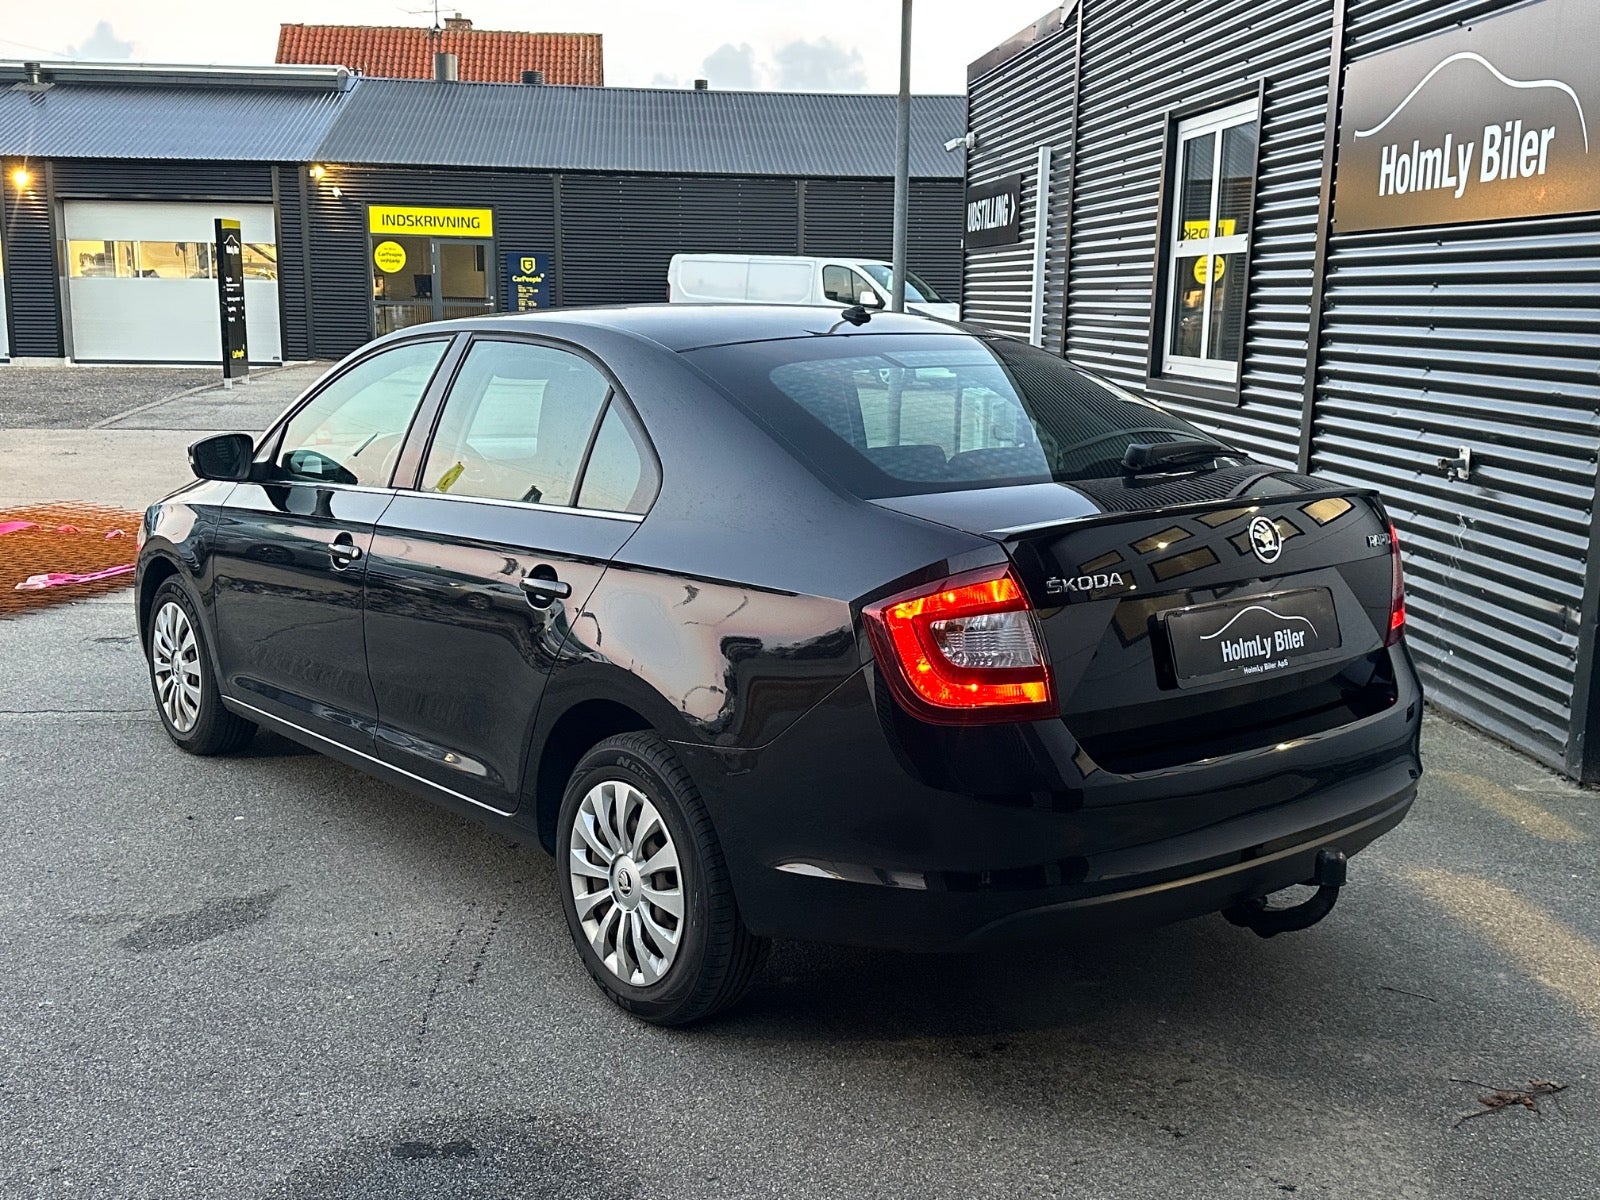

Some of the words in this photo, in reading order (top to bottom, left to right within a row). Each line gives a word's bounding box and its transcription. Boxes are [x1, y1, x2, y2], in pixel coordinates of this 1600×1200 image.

[1379, 133, 1475, 199] HolmLy
[1479, 119, 1556, 183] Biler
[381, 213, 481, 229] INDSKRIVNING
[967, 193, 1009, 233] UDSTILLING
[1045, 572, 1124, 595] ŠKODA
[1221, 635, 1271, 662] HolmLy
[1274, 628, 1305, 652] Biler
[1243, 664, 1264, 675] HolmLy
[1264, 662, 1277, 671] Biler
[1277, 658, 1289, 669] ApS
